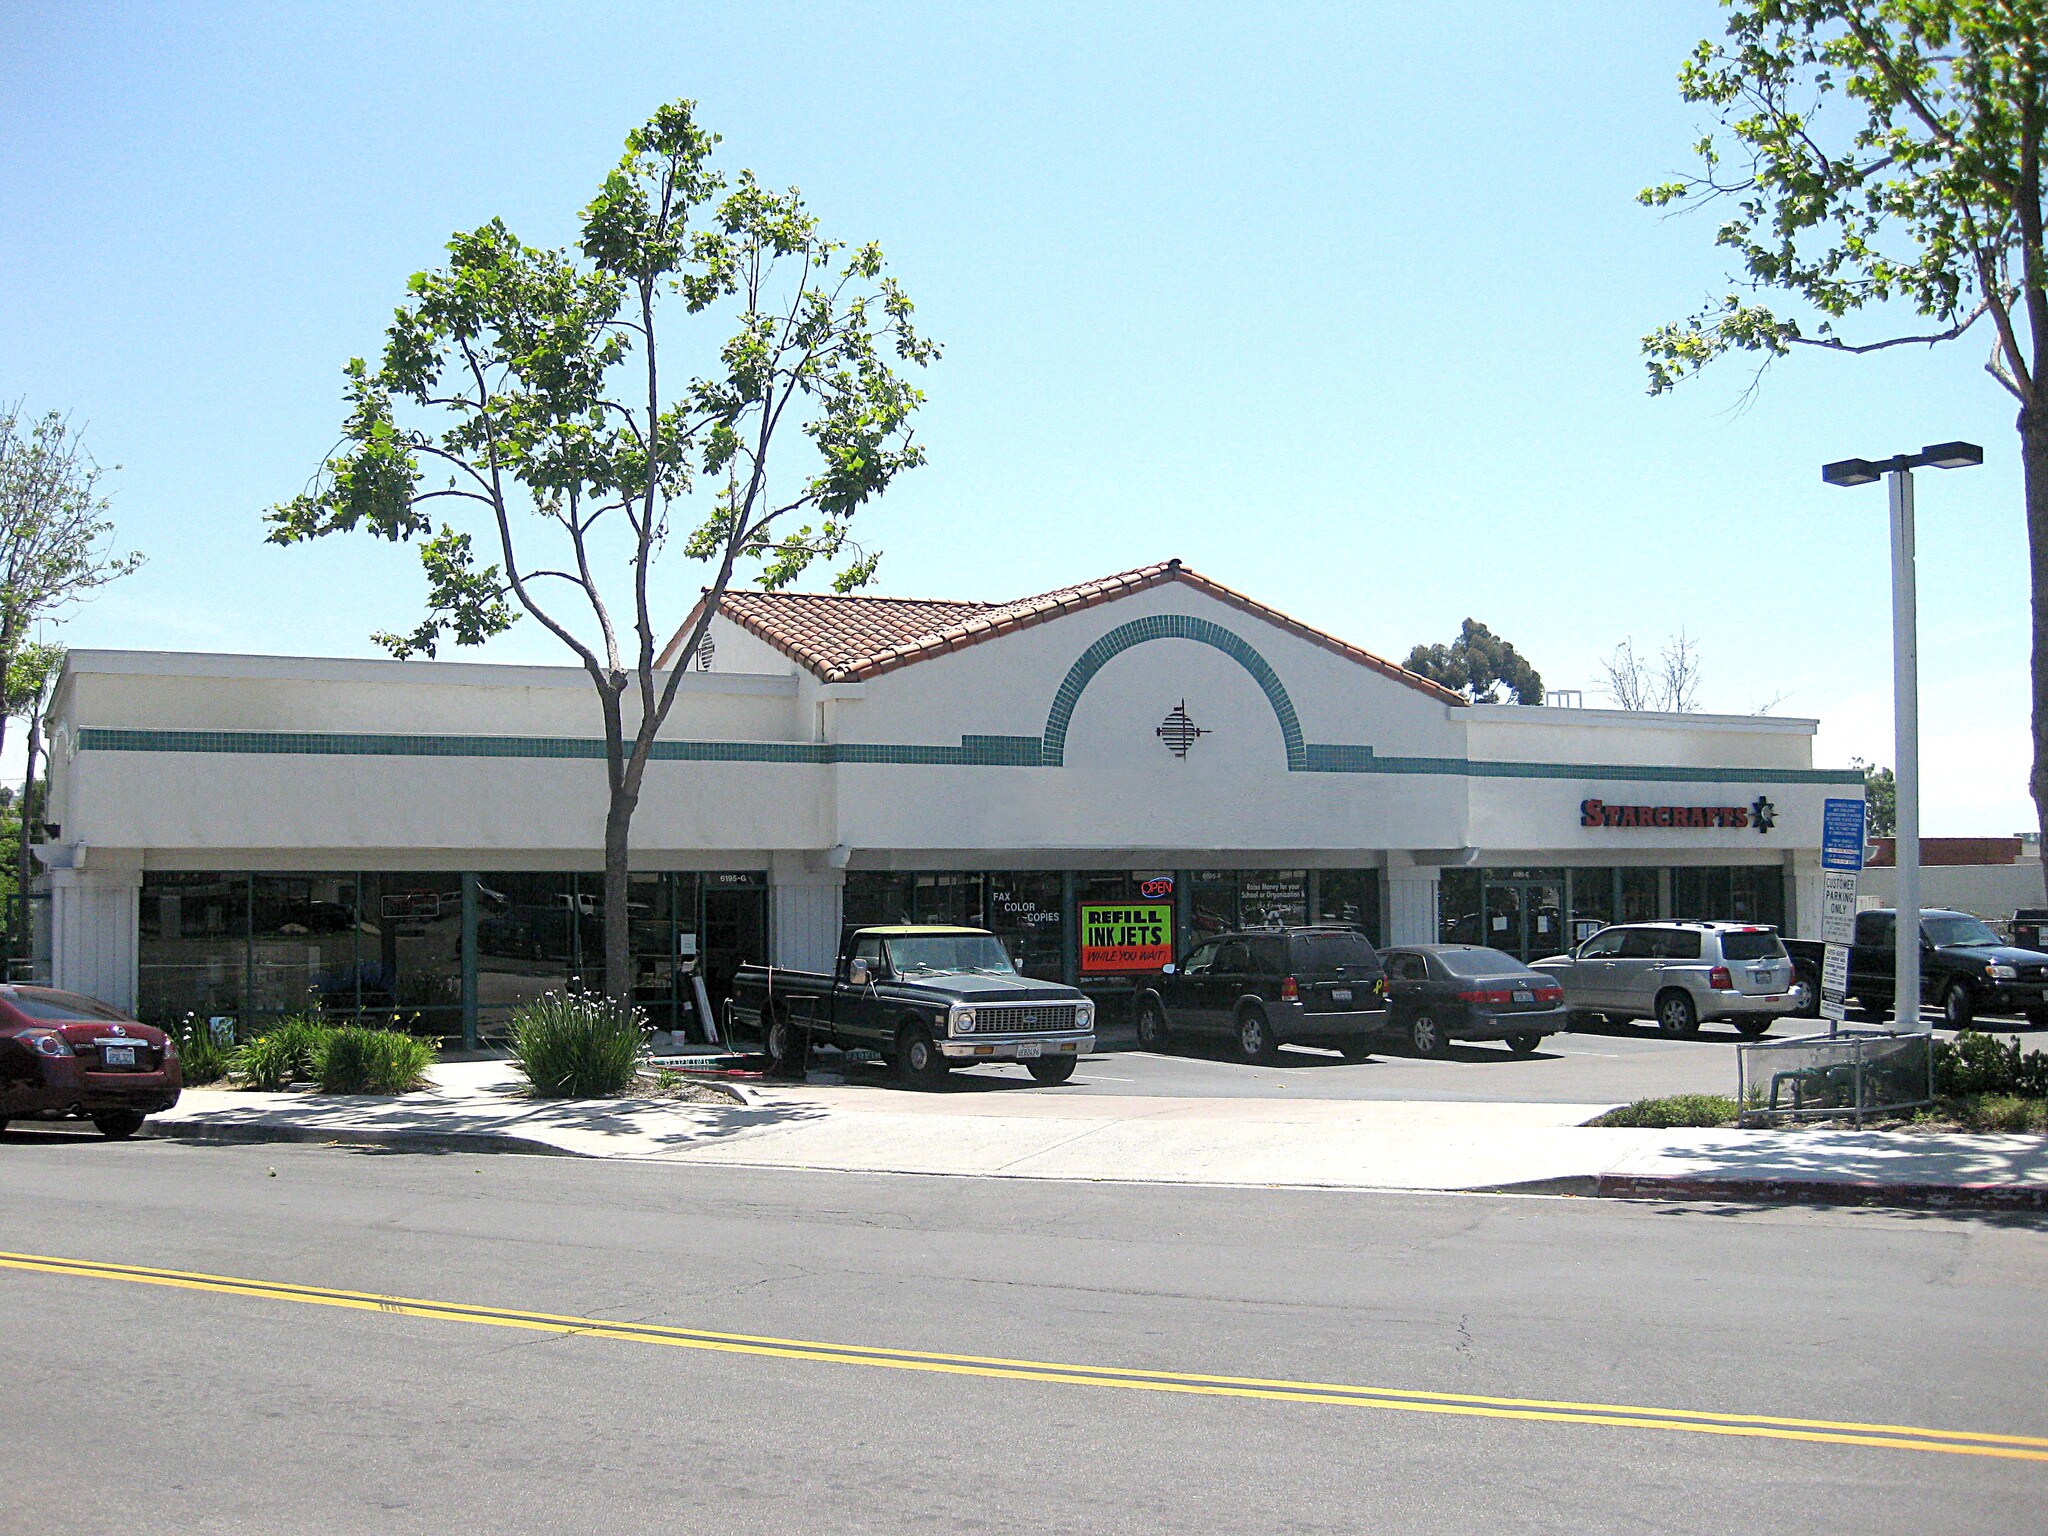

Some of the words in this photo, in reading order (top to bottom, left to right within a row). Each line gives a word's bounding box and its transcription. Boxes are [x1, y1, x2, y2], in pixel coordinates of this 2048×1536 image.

[1581, 799, 1748, 828] STARCRAFTS
[720, 874, 747, 882] 6195-G
[1141, 881, 1172, 894] OPEN
[1246, 883, 1260, 891] Raise
[1262, 883, 1279, 892] Money
[1288, 884, 1300, 892] your
[1826, 877, 1854, 890] CUSTOMER
[993, 892, 1011, 902] FAX
[1266, 891, 1300, 900] Organization
[1826, 890, 1853, 903] PARKING
[1004, 902, 1036, 912] COLOR
[1831, 903, 1847, 914] ONLY
[1027, 912, 1060, 922] COPIES
[1088, 911, 1163, 924] REFILL
[1087, 950, 1117, 962] WHILE
[1119, 950, 1137, 961] YOU
[845, 1051, 881, 1060] PARKIN
